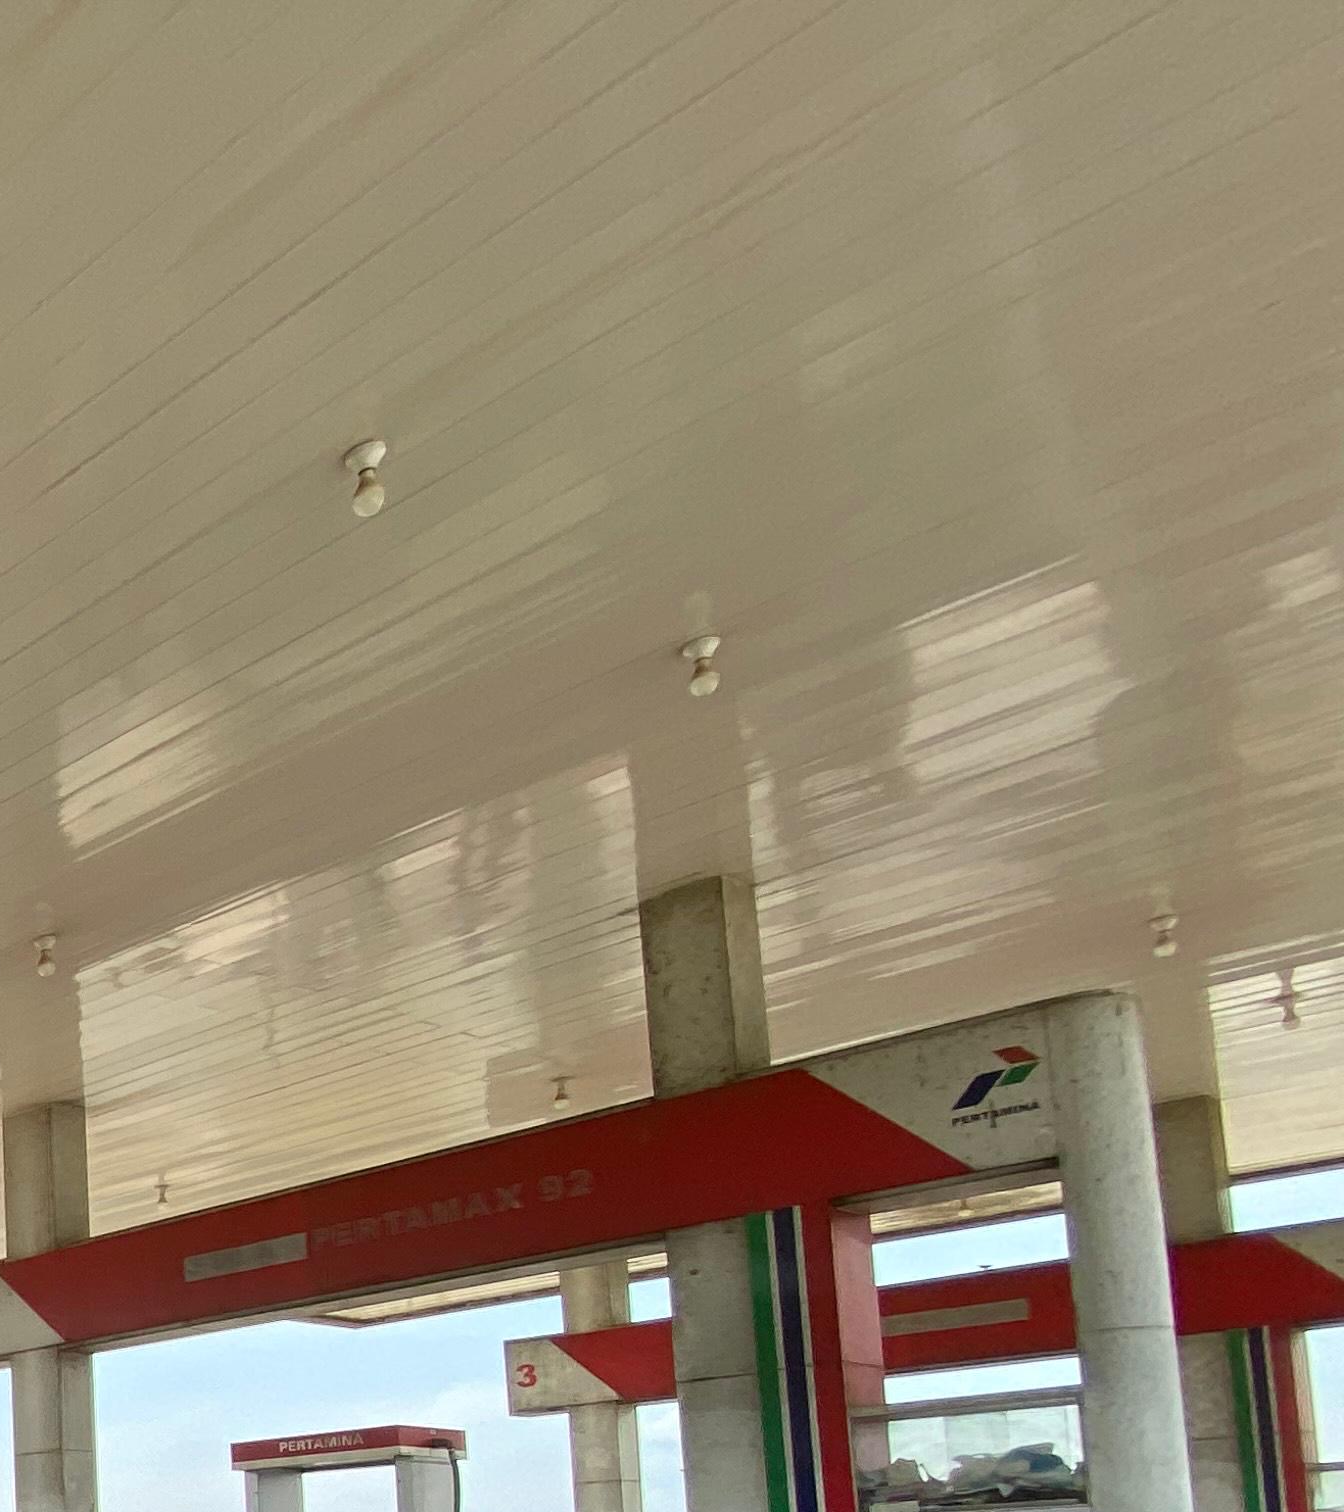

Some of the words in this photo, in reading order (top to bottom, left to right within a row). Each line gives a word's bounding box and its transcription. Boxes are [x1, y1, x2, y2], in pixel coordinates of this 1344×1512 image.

[313, 1183, 523, 1250] PERTAMAX
[537, 1168, 595, 1202] 92
[516, 1364, 537, 1388] 3
[278, 1433, 364, 1452] PERTAMINA
